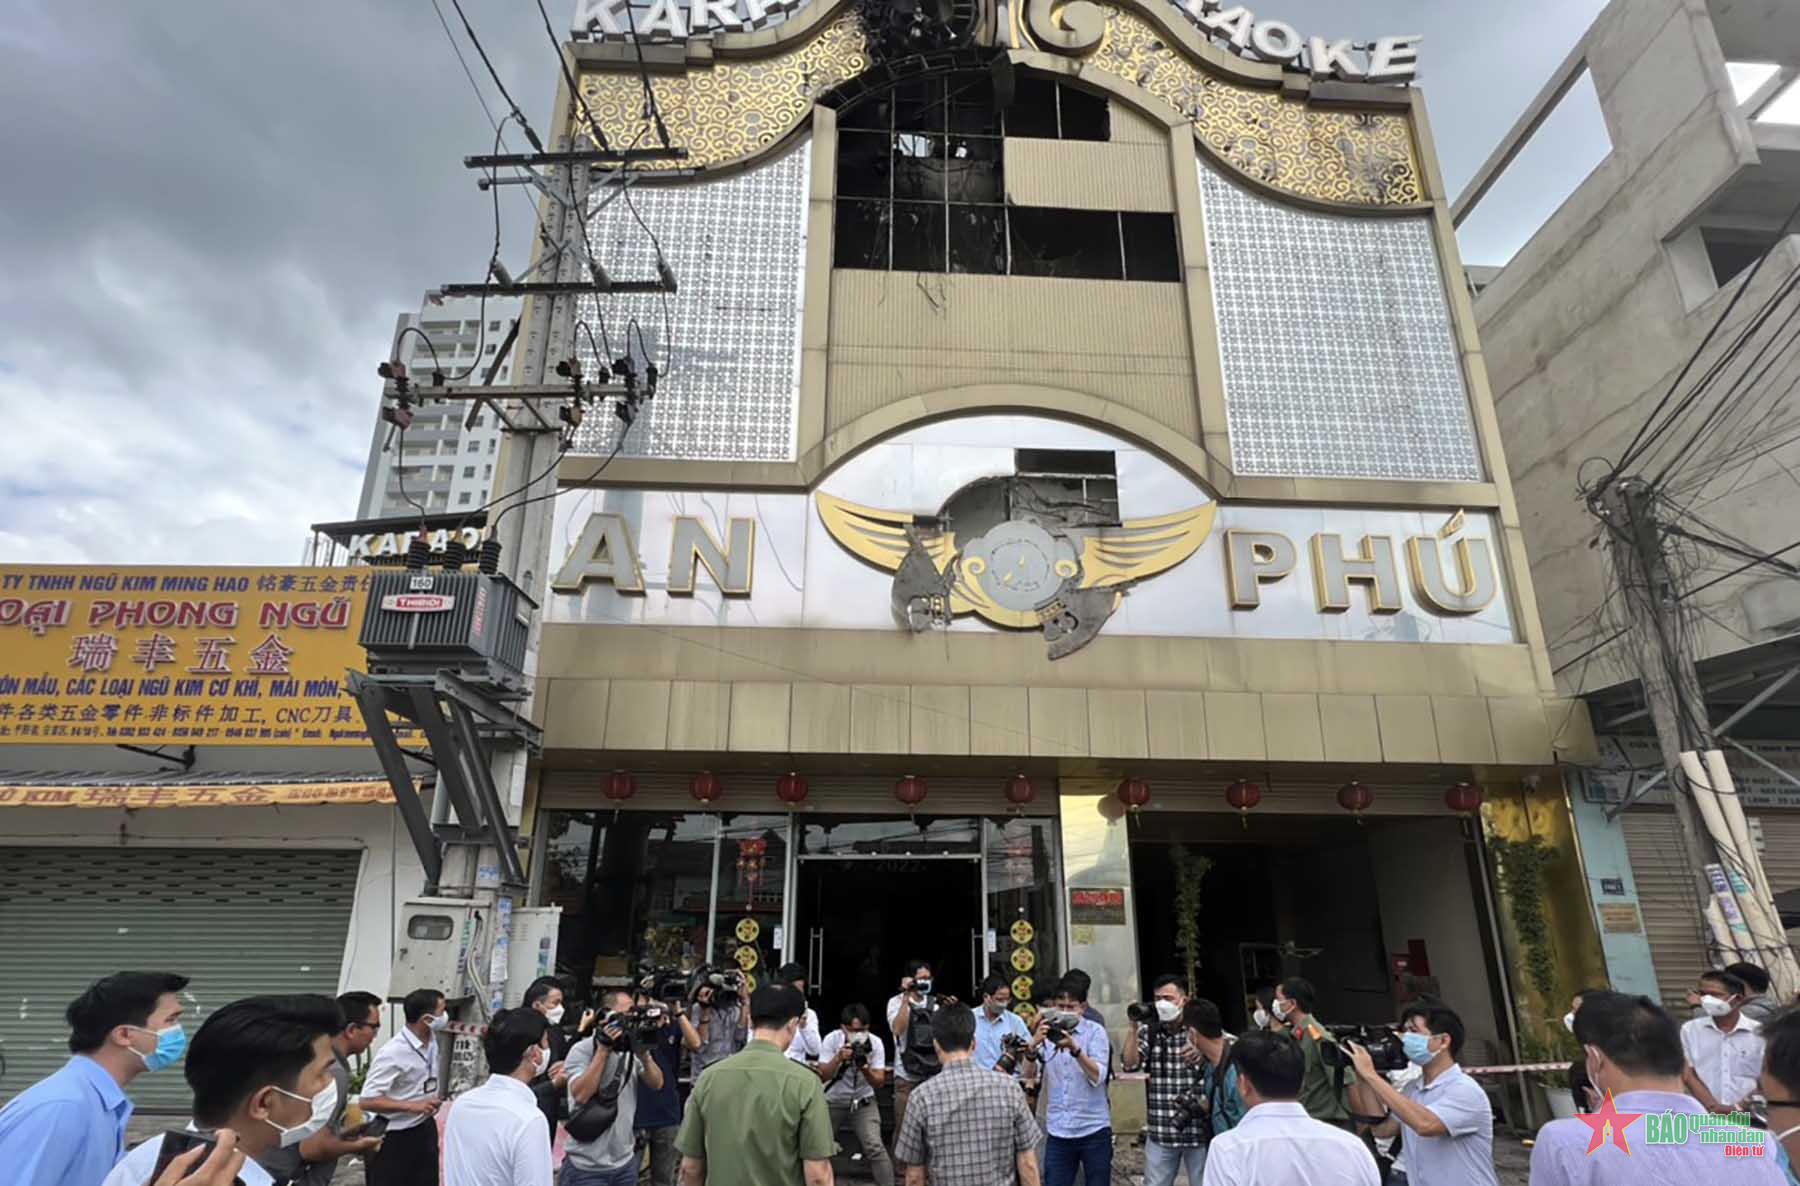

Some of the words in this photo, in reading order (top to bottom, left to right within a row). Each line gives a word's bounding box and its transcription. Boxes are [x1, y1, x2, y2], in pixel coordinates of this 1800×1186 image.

[551, 513, 756, 598] AN
[1224, 508, 1499, 617] PHÚ
[3, 575, 24, 590] TY
[29, 575, 75, 590] TNHH
[122, 576, 157, 590] KIM
[161, 576, 209, 591] MING
[213, 576, 249, 591] HAO
[88, 599, 239, 629] PHONG
[258, 596, 351, 629] NGŨ
[68, 632, 294, 675] 瑞丰五金
[100, 678, 134, 698] LOẠI
[174, 679, 204, 696] KIM
